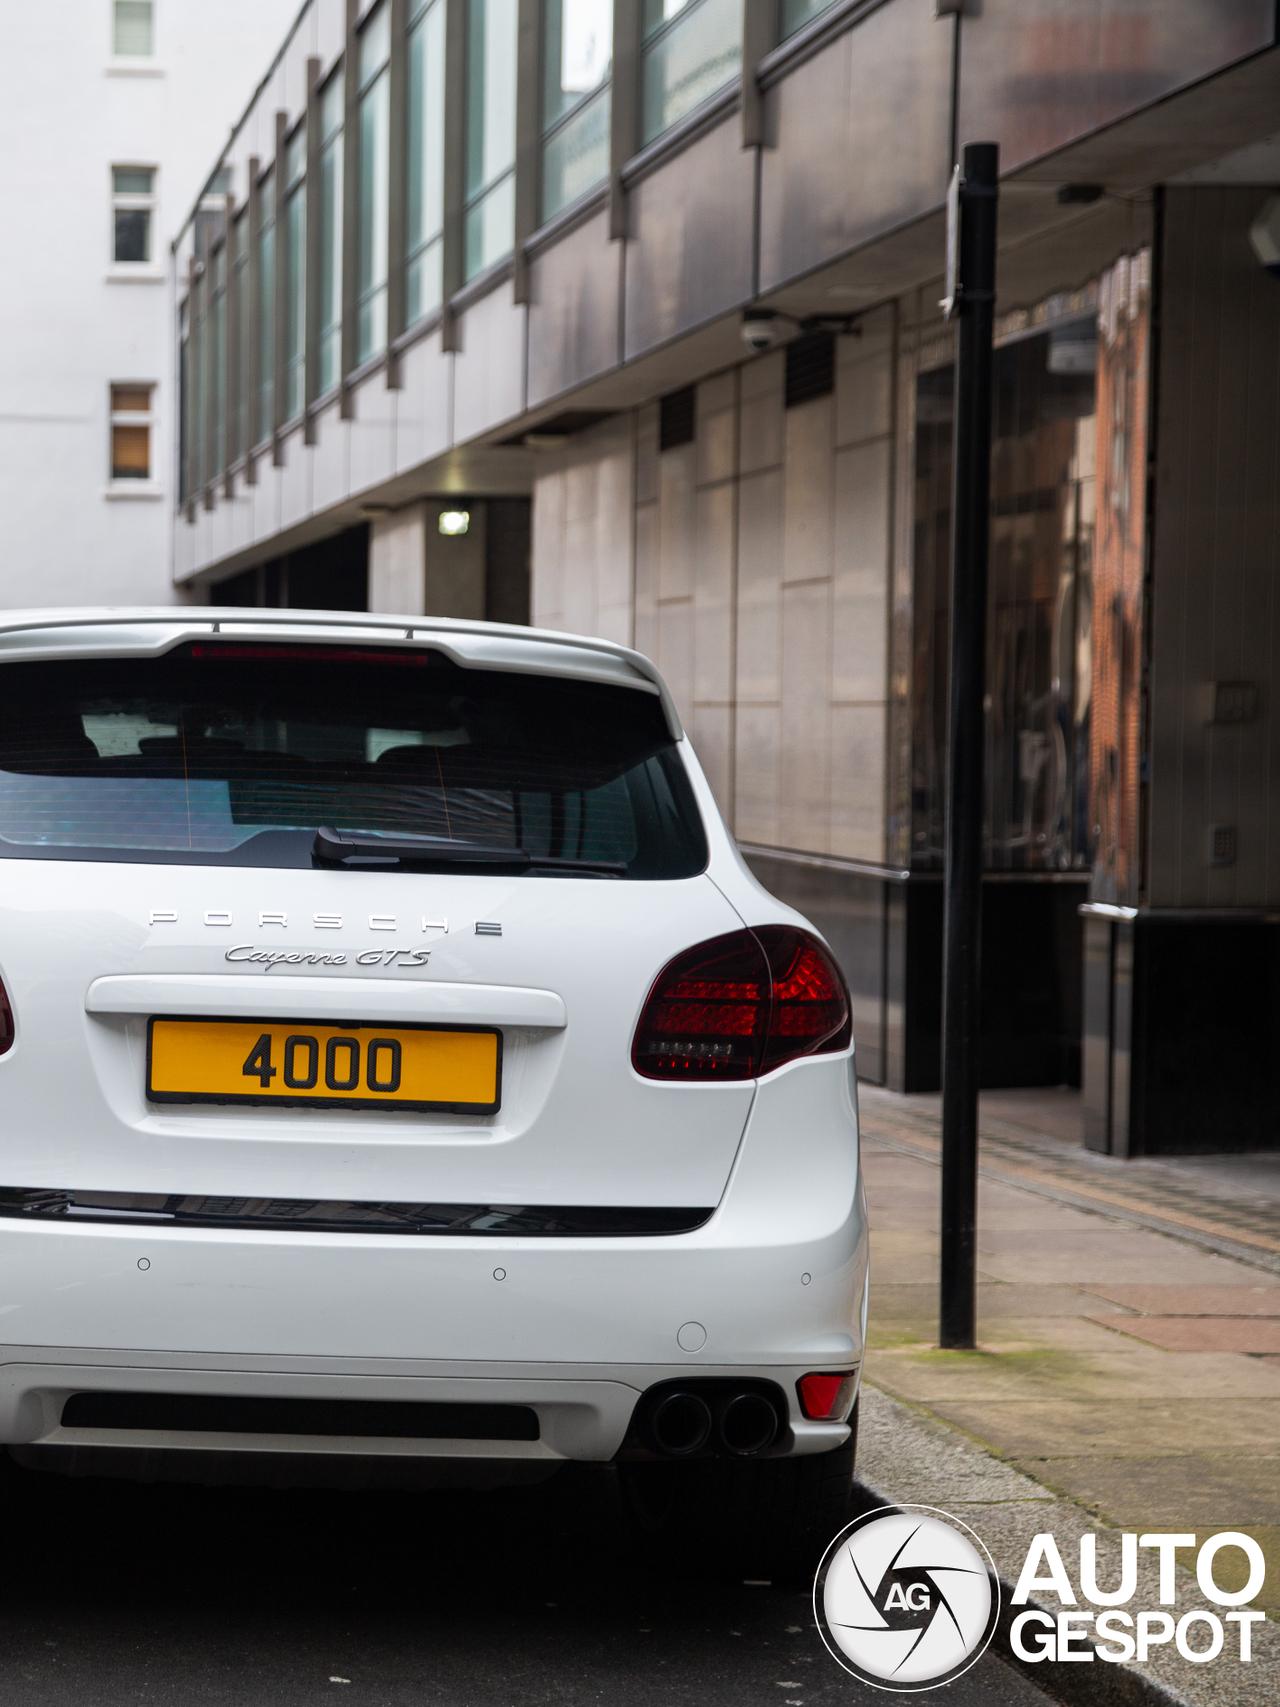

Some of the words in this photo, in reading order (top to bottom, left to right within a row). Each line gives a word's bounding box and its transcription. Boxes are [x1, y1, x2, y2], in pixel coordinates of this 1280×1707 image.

[149, 909, 503, 937] PORSCHE
[225, 944, 349, 972] Cayenne
[355, 948, 432, 967] GTS
[242, 1033, 402, 1093] 4000
